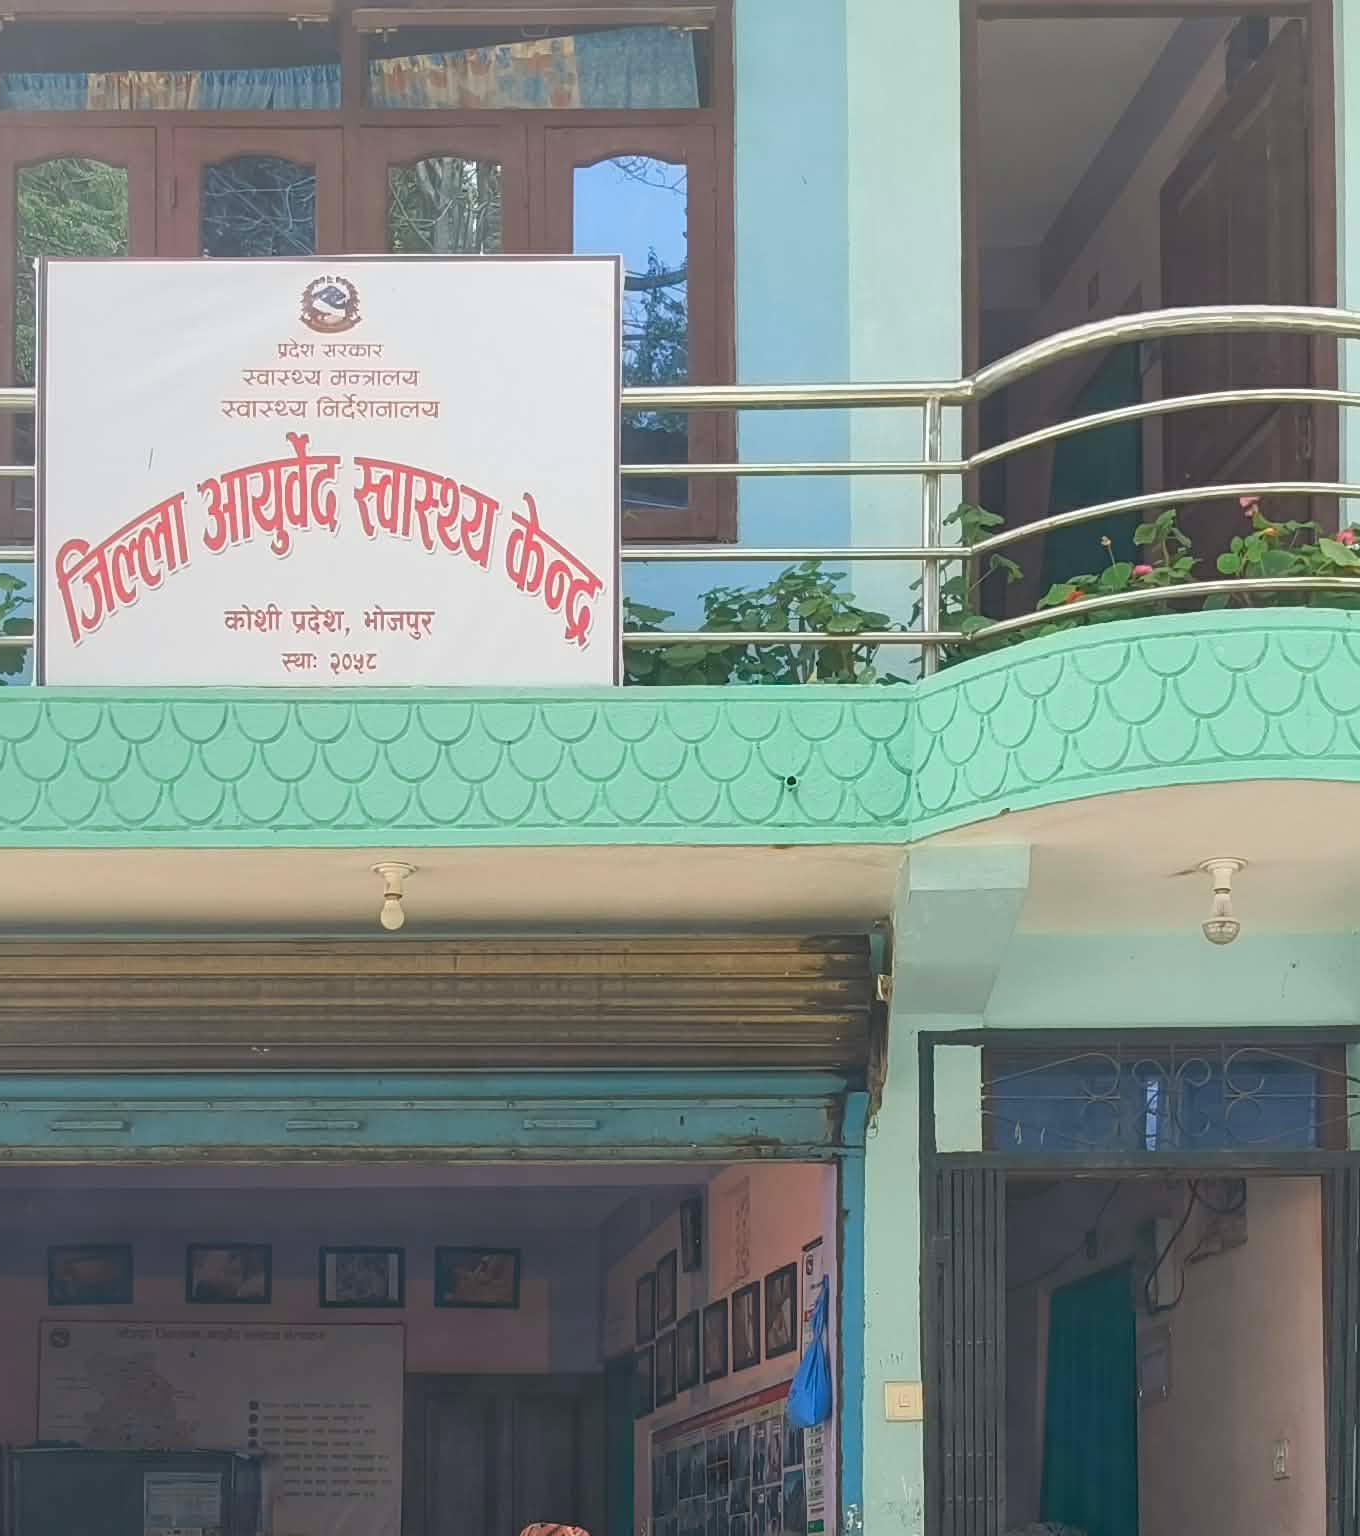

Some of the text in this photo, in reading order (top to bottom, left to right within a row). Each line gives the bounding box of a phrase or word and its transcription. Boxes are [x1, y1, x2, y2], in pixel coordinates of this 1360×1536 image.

[277, 339, 383, 361] प्रदेश सरकार
[242, 367, 420, 388] स्वास्थ्य मन्त्रालय
[221, 394, 440, 420] स्वास्थ्य निर्देशनालय
[55, 431, 603, 648] जिल्ला आयुर्वेद स्वास्थ्य केन्द्र
[223, 604, 435, 638] कोशी प्रदेश, भोजपुर
[330, 654, 377, 673] २०५८
